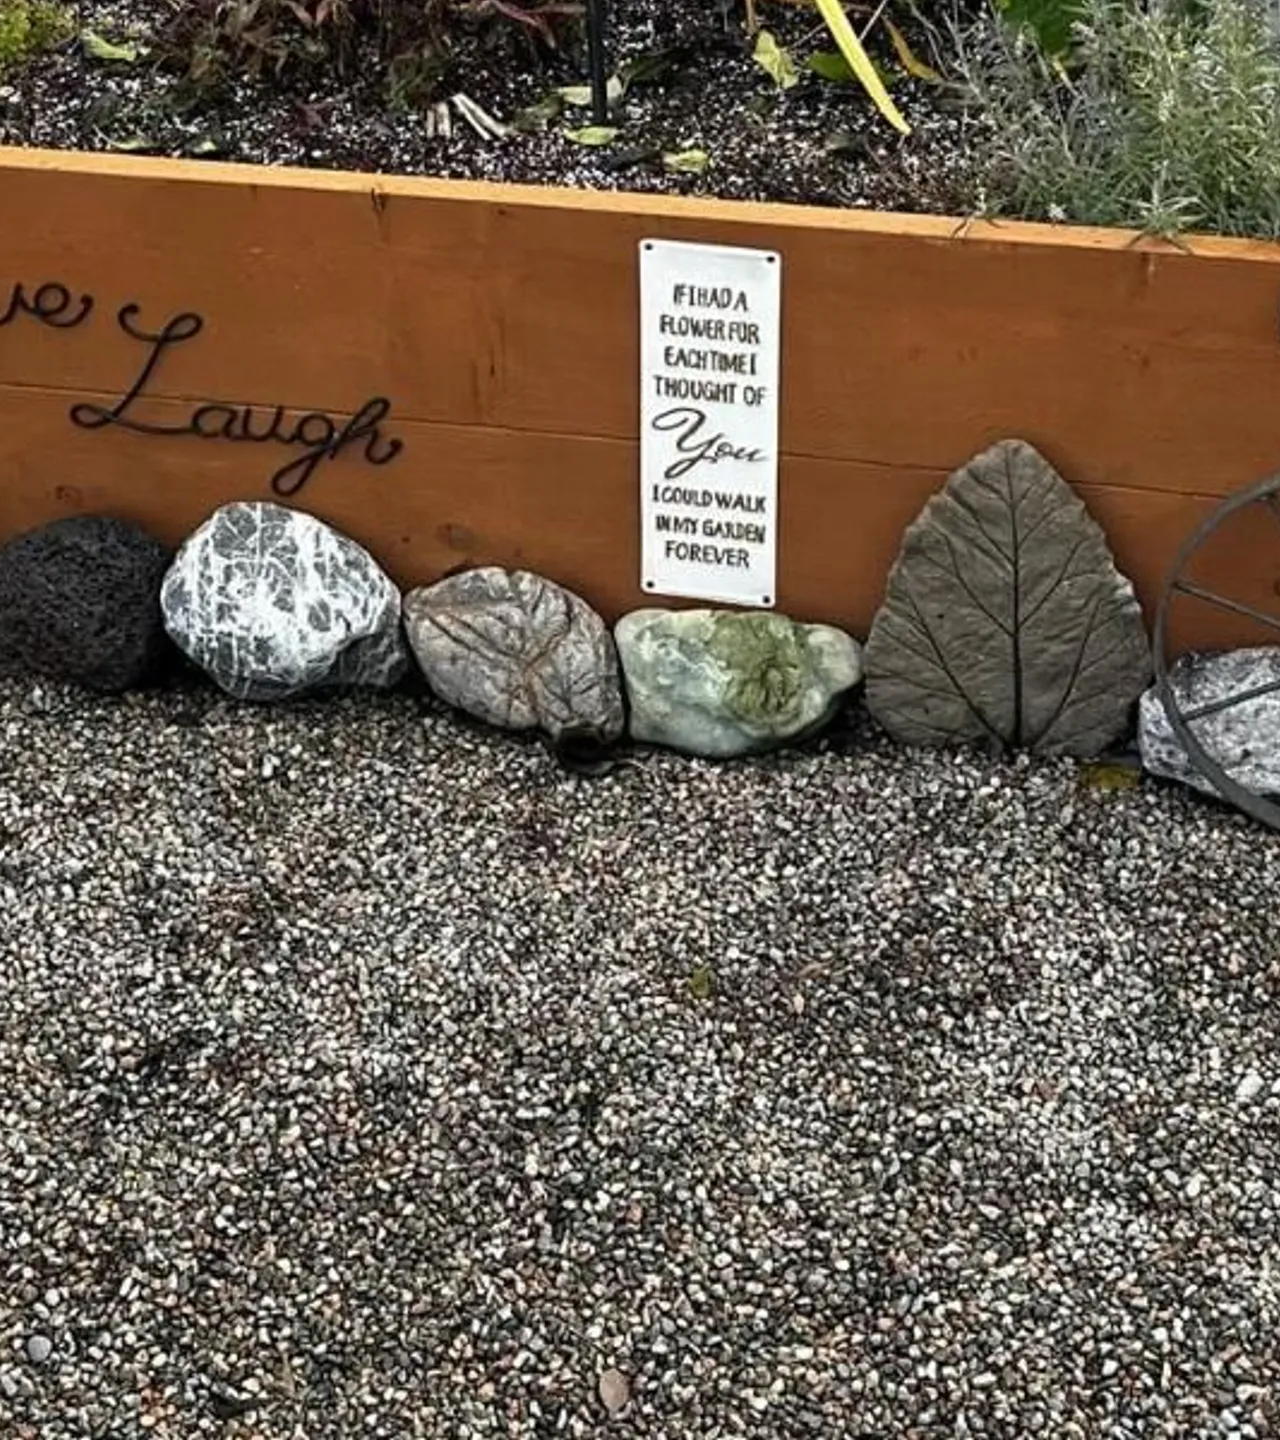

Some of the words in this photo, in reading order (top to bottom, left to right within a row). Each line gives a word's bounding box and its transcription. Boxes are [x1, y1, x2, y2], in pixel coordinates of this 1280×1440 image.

[673, 283, 687, 305] IF
[688, 286, 696, 307] I
[698, 287, 733, 309] HAD
[734, 291, 748, 312] A
[660, 314, 726, 341] FLOWER
[664, 346, 708, 370] EACH
[709, 350, 747, 375] TIME
[750, 353, 757, 376] I
[69, 303, 404, 497] Laugh
[653, 374, 738, 404] THOUGHT
[744, 386, 766, 407] OF
[651, 407, 769, 479] You
[652, 484, 659, 503] I
[661, 485, 713, 507] COULD
[714, 491, 766, 513] WALK
[655, 514, 671, 532] IN
[673, 516, 698, 535] MY
[702, 519, 766, 544] GARDEN
[665, 540, 750, 569] FOREVER
